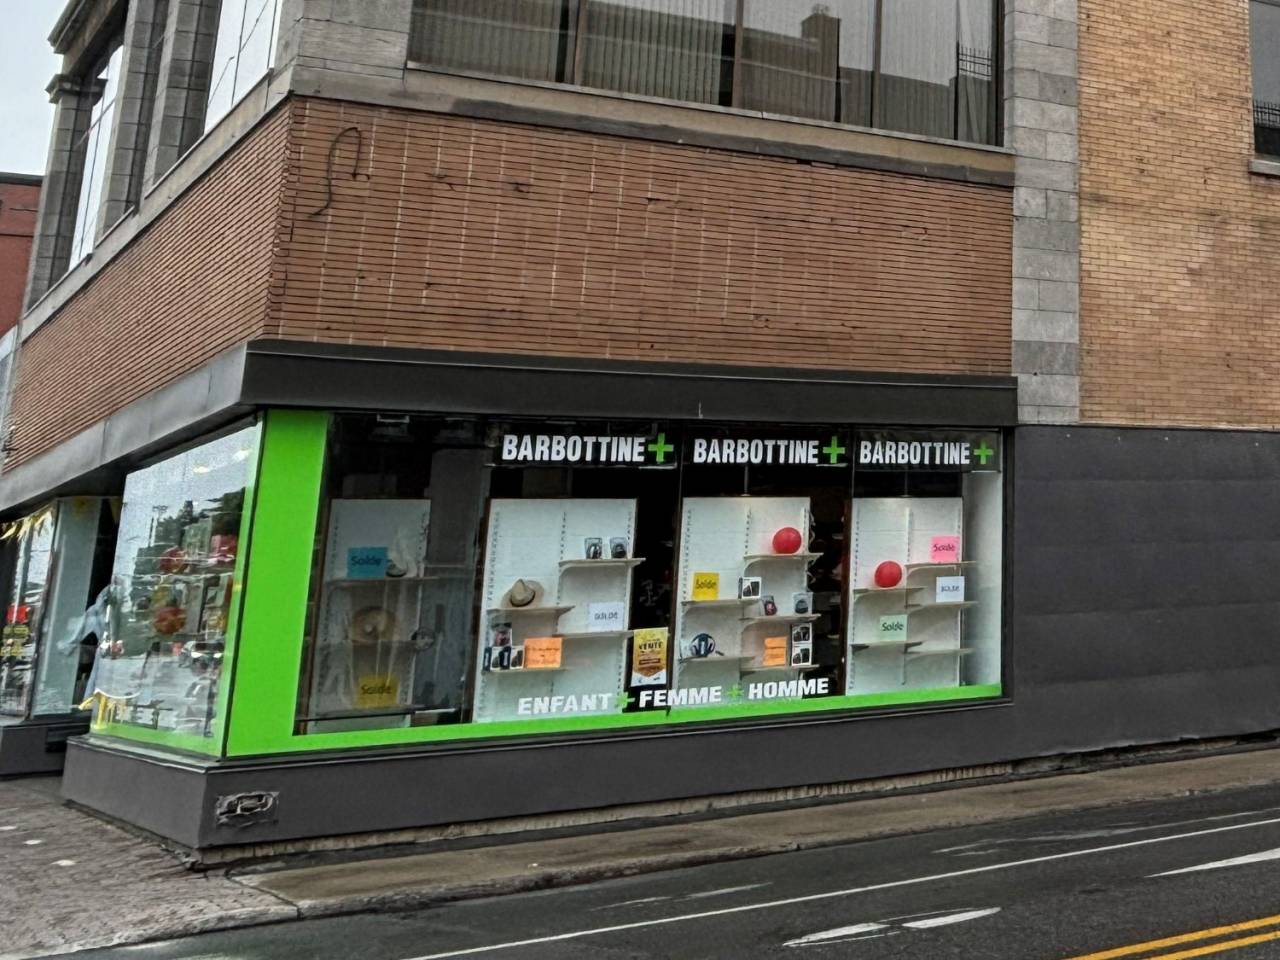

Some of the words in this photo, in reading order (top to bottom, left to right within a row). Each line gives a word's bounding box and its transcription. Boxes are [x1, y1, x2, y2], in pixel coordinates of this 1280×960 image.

[882, 622, 904, 632] Solde
[639, 641, 663, 650] VENTE
[518, 693, 612, 715] ENFANT
[639, 686, 722, 708] FEMME
[749, 678, 829, 700] HOMME
